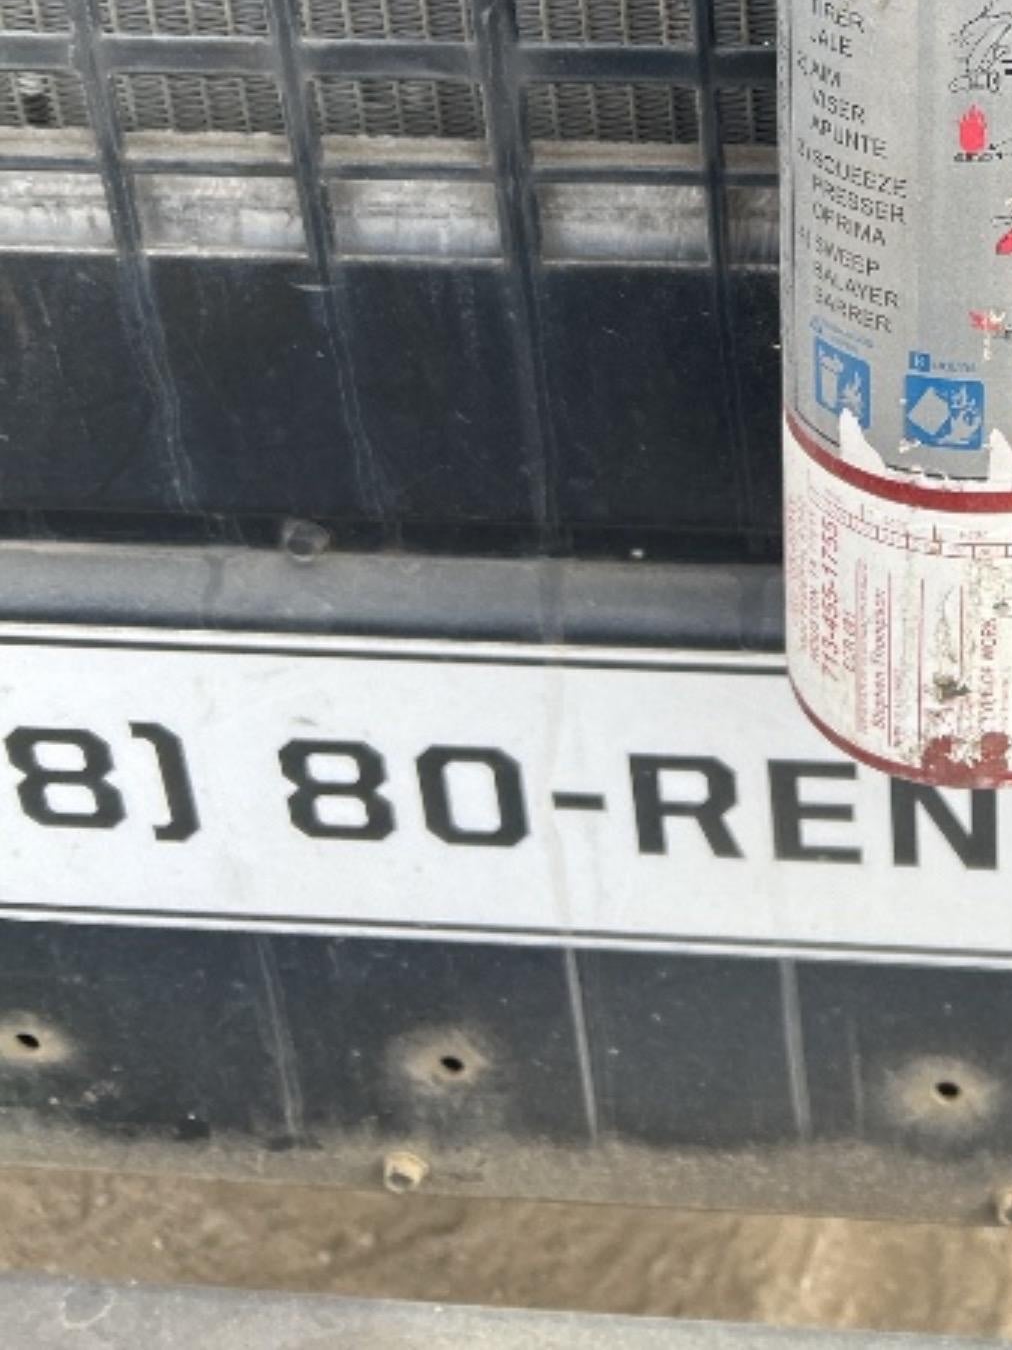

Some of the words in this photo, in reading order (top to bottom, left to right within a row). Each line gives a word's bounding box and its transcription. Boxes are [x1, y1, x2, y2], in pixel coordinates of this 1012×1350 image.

[812, 149, 908, 200] SQUEEZE
[812, 173, 906, 226] PRESSER
[812, 201, 887, 247] OPRIMA
[814, 233, 881, 277] SWEEP
[813, 260, 900, 308] BALAYER
[821, 515, 838, 682] 713-455-1755
